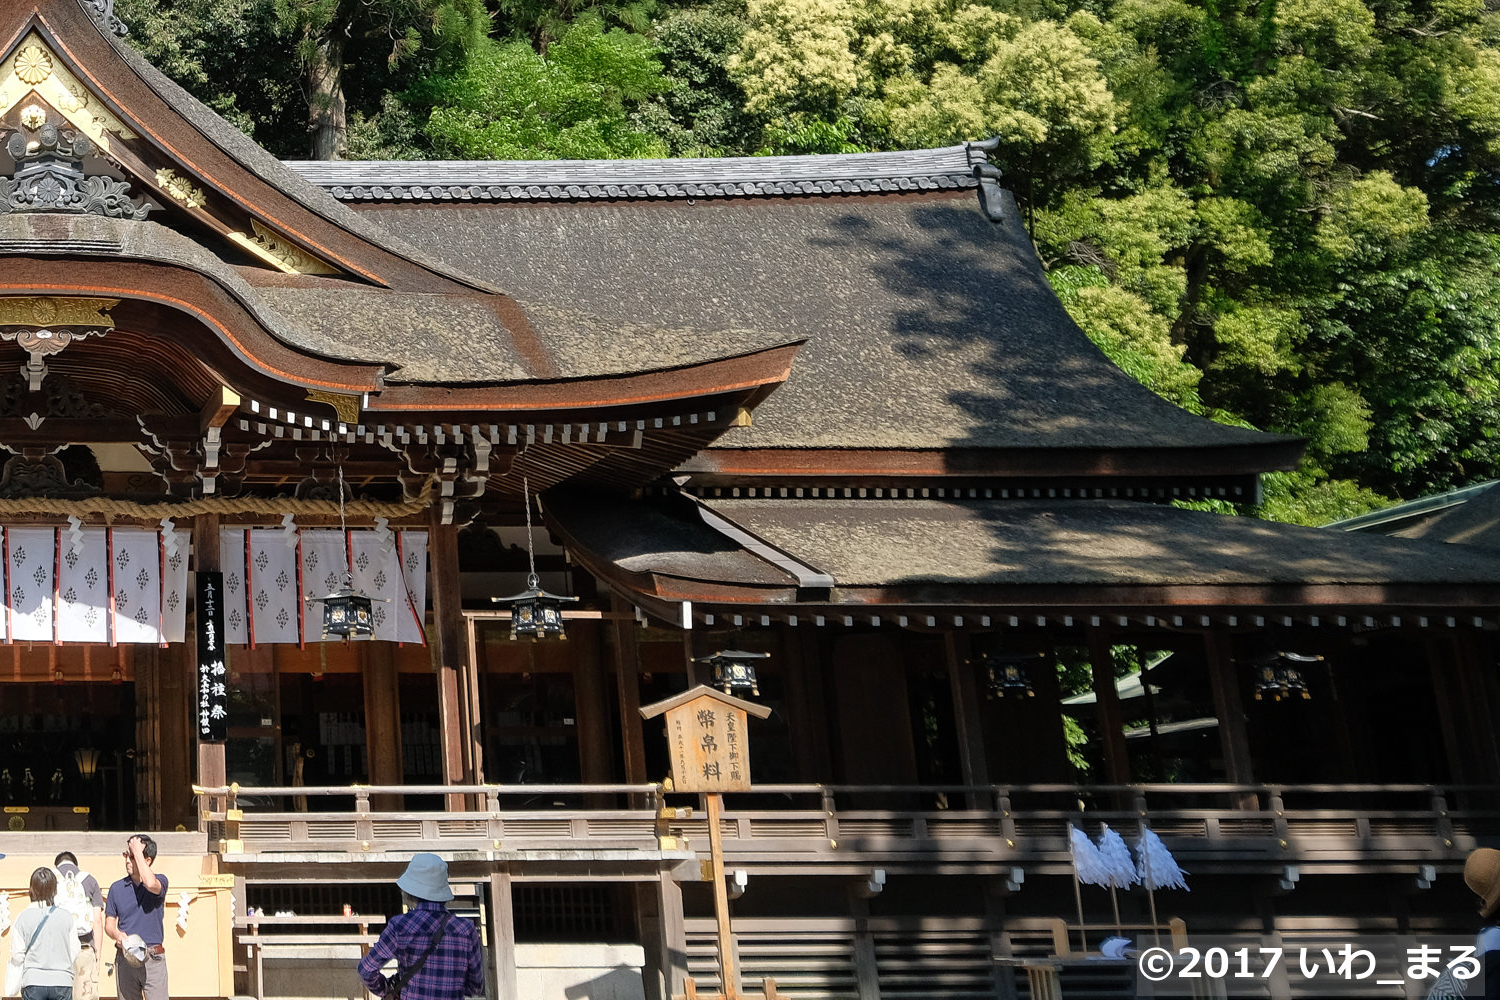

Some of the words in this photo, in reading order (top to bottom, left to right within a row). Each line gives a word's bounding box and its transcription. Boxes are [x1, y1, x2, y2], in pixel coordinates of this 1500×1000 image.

[210, 660, 228, 720] 播種祭
[696, 709, 722, 782] 幣帛料
[725, 712, 741, 781] 天皇陛下御下賜
